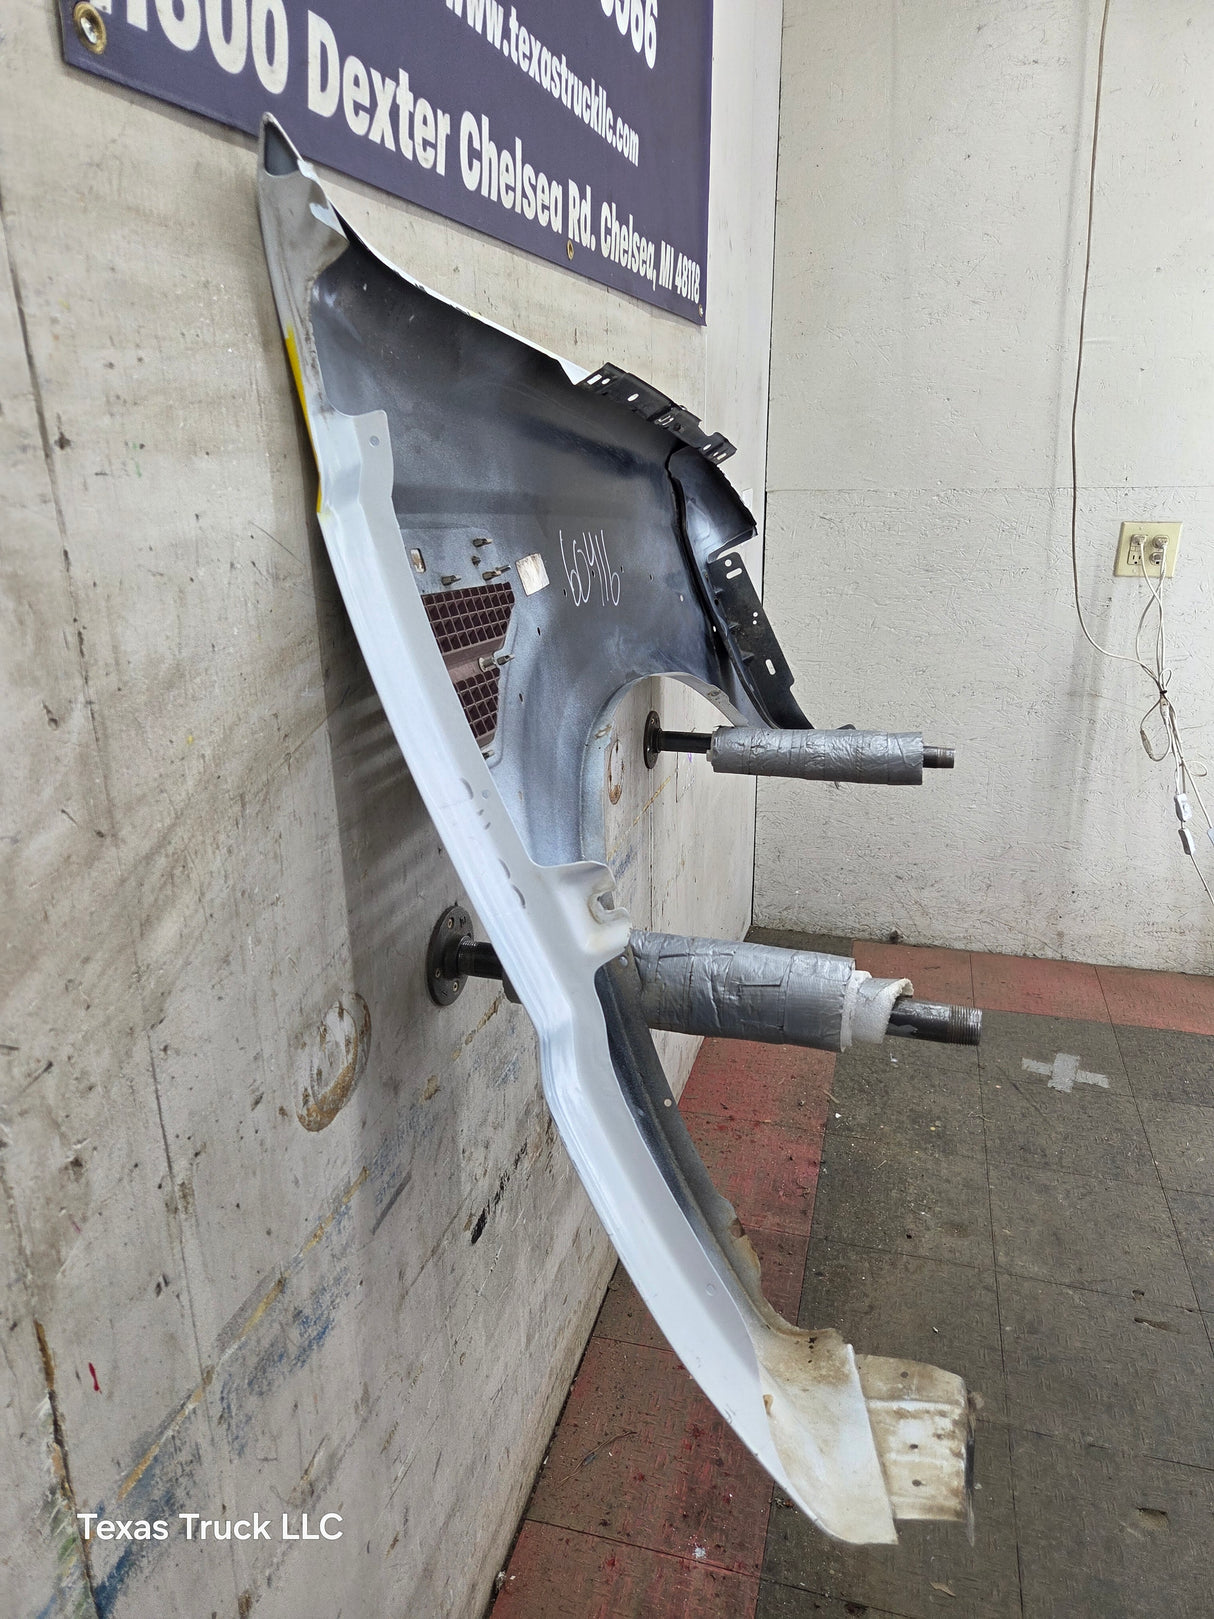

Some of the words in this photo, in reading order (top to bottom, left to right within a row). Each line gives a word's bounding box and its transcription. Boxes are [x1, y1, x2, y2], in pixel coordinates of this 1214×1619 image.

[308, 9, 451, 177] Dexter
[460, 110, 563, 234] Chelsea
[568, 178, 596, 252] Rd.
[600, 201, 657, 292] Chelsea,
[658, 240, 675, 290] MI
[675, 252, 701, 304] 48118
[445, 0, 639, 167] ww.texastruckllc.com
